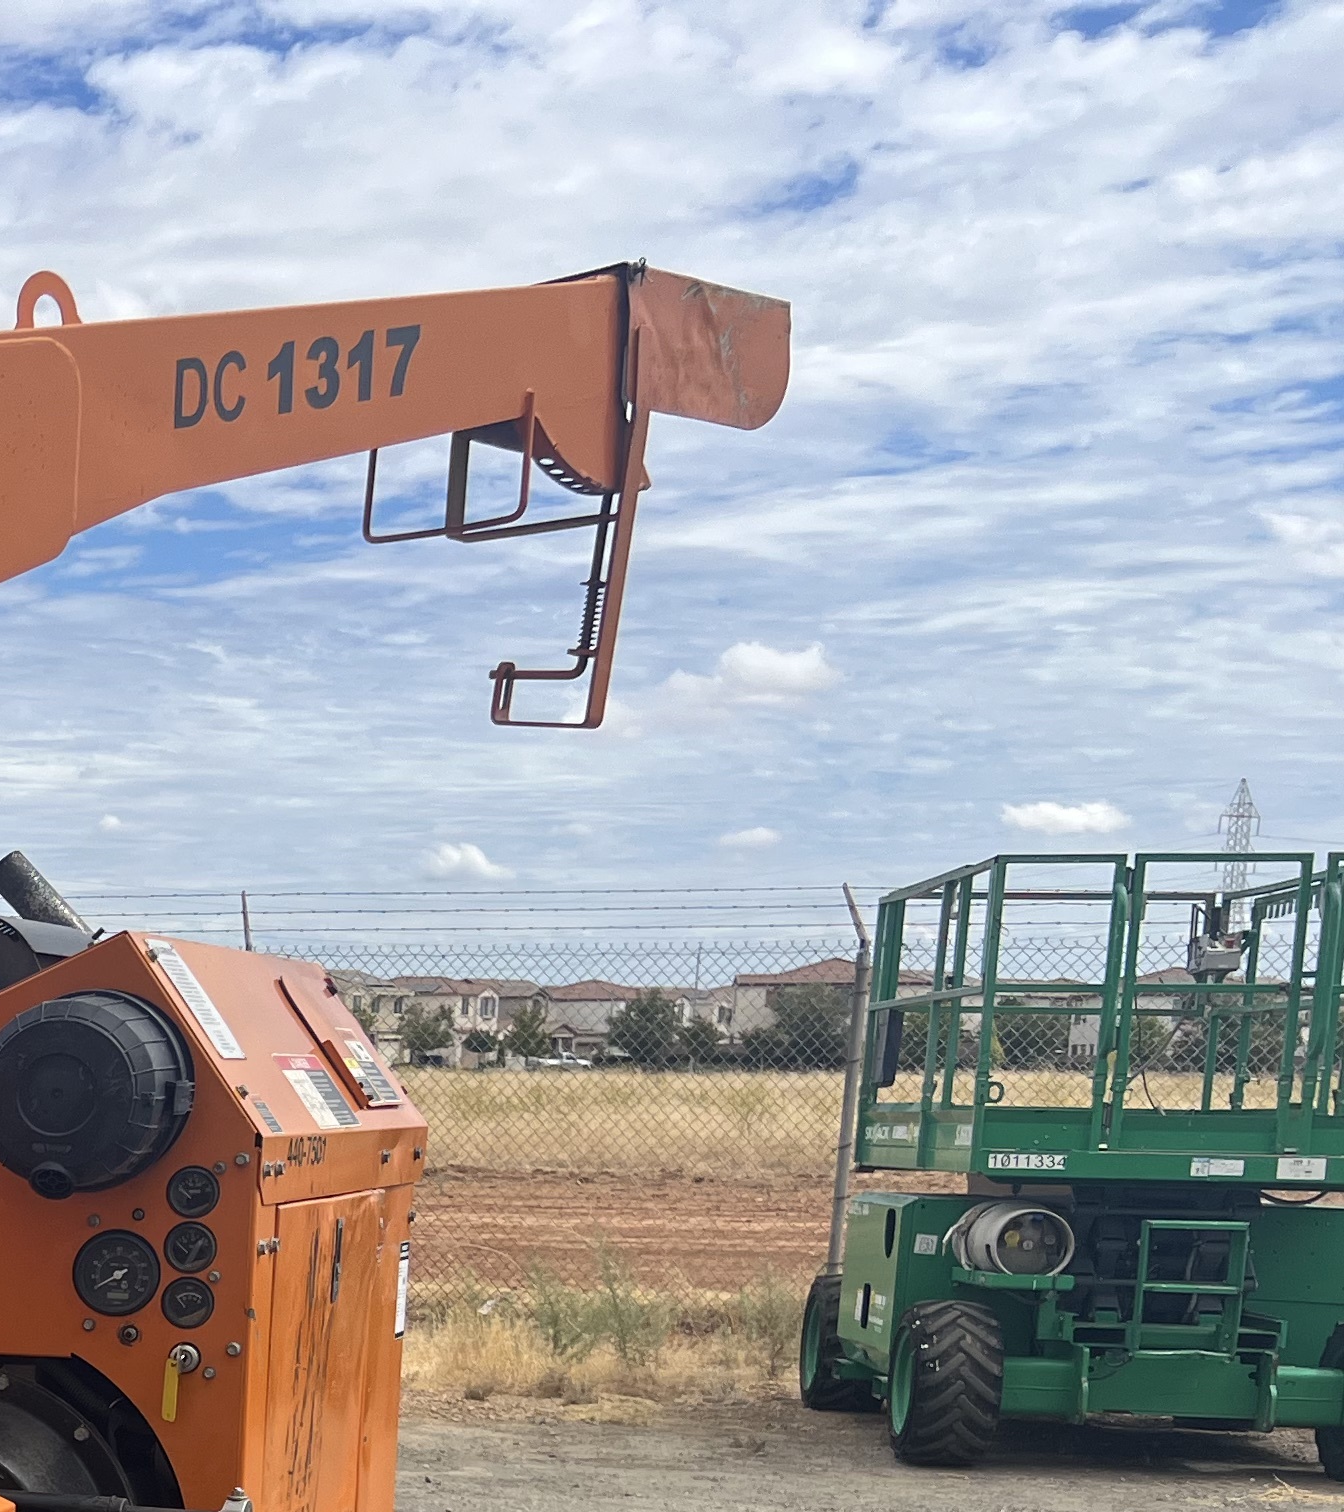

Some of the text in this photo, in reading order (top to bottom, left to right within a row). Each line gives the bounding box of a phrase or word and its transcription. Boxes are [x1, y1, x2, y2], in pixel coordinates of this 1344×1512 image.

[174, 324, 421, 429] DC 1317
[991, 1155, 1067, 1169] 1011334
